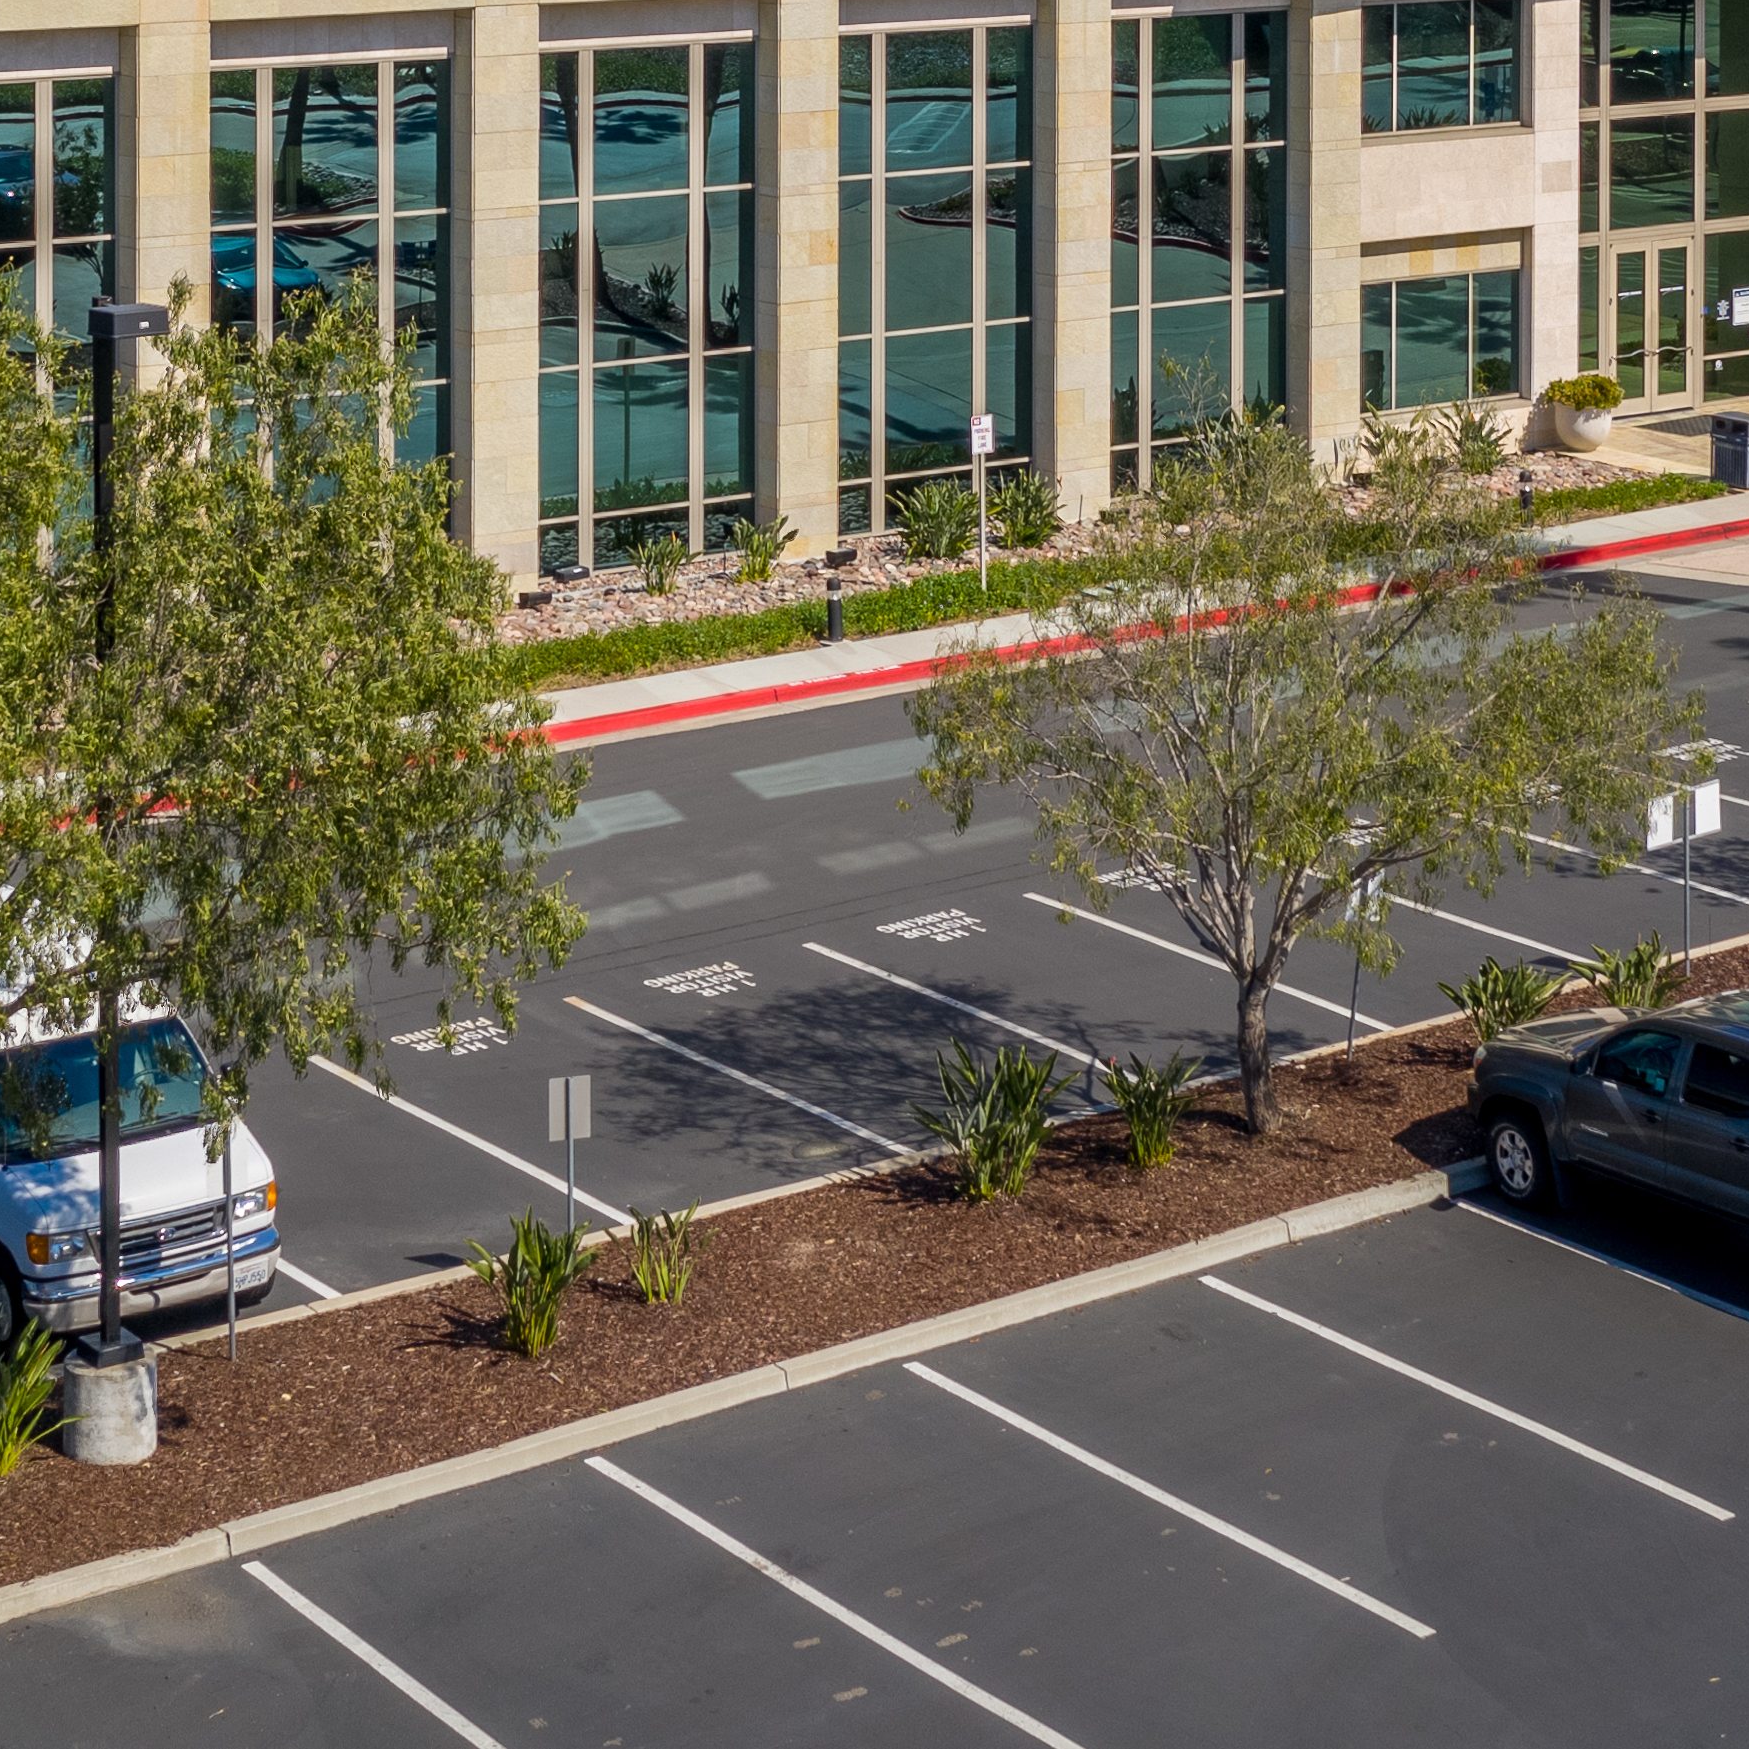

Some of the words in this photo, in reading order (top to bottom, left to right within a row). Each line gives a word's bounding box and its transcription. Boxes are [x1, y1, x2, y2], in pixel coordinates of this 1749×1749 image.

[876, 908, 966, 933] PARKING
[896, 916, 982, 939] VISITOR
[930, 929, 970, 942] HR
[970, 925, 987, 933] 1
[643, 961, 740, 988] PARKING
[663, 970, 754, 994] VISITOR
[740, 979, 756, 987] 1
[696, 983, 739, 997] HR
[410, 1025, 507, 1052] VISIOR
[492, 1036, 508, 1045] 1
[451, 1041, 489, 1055] HR
